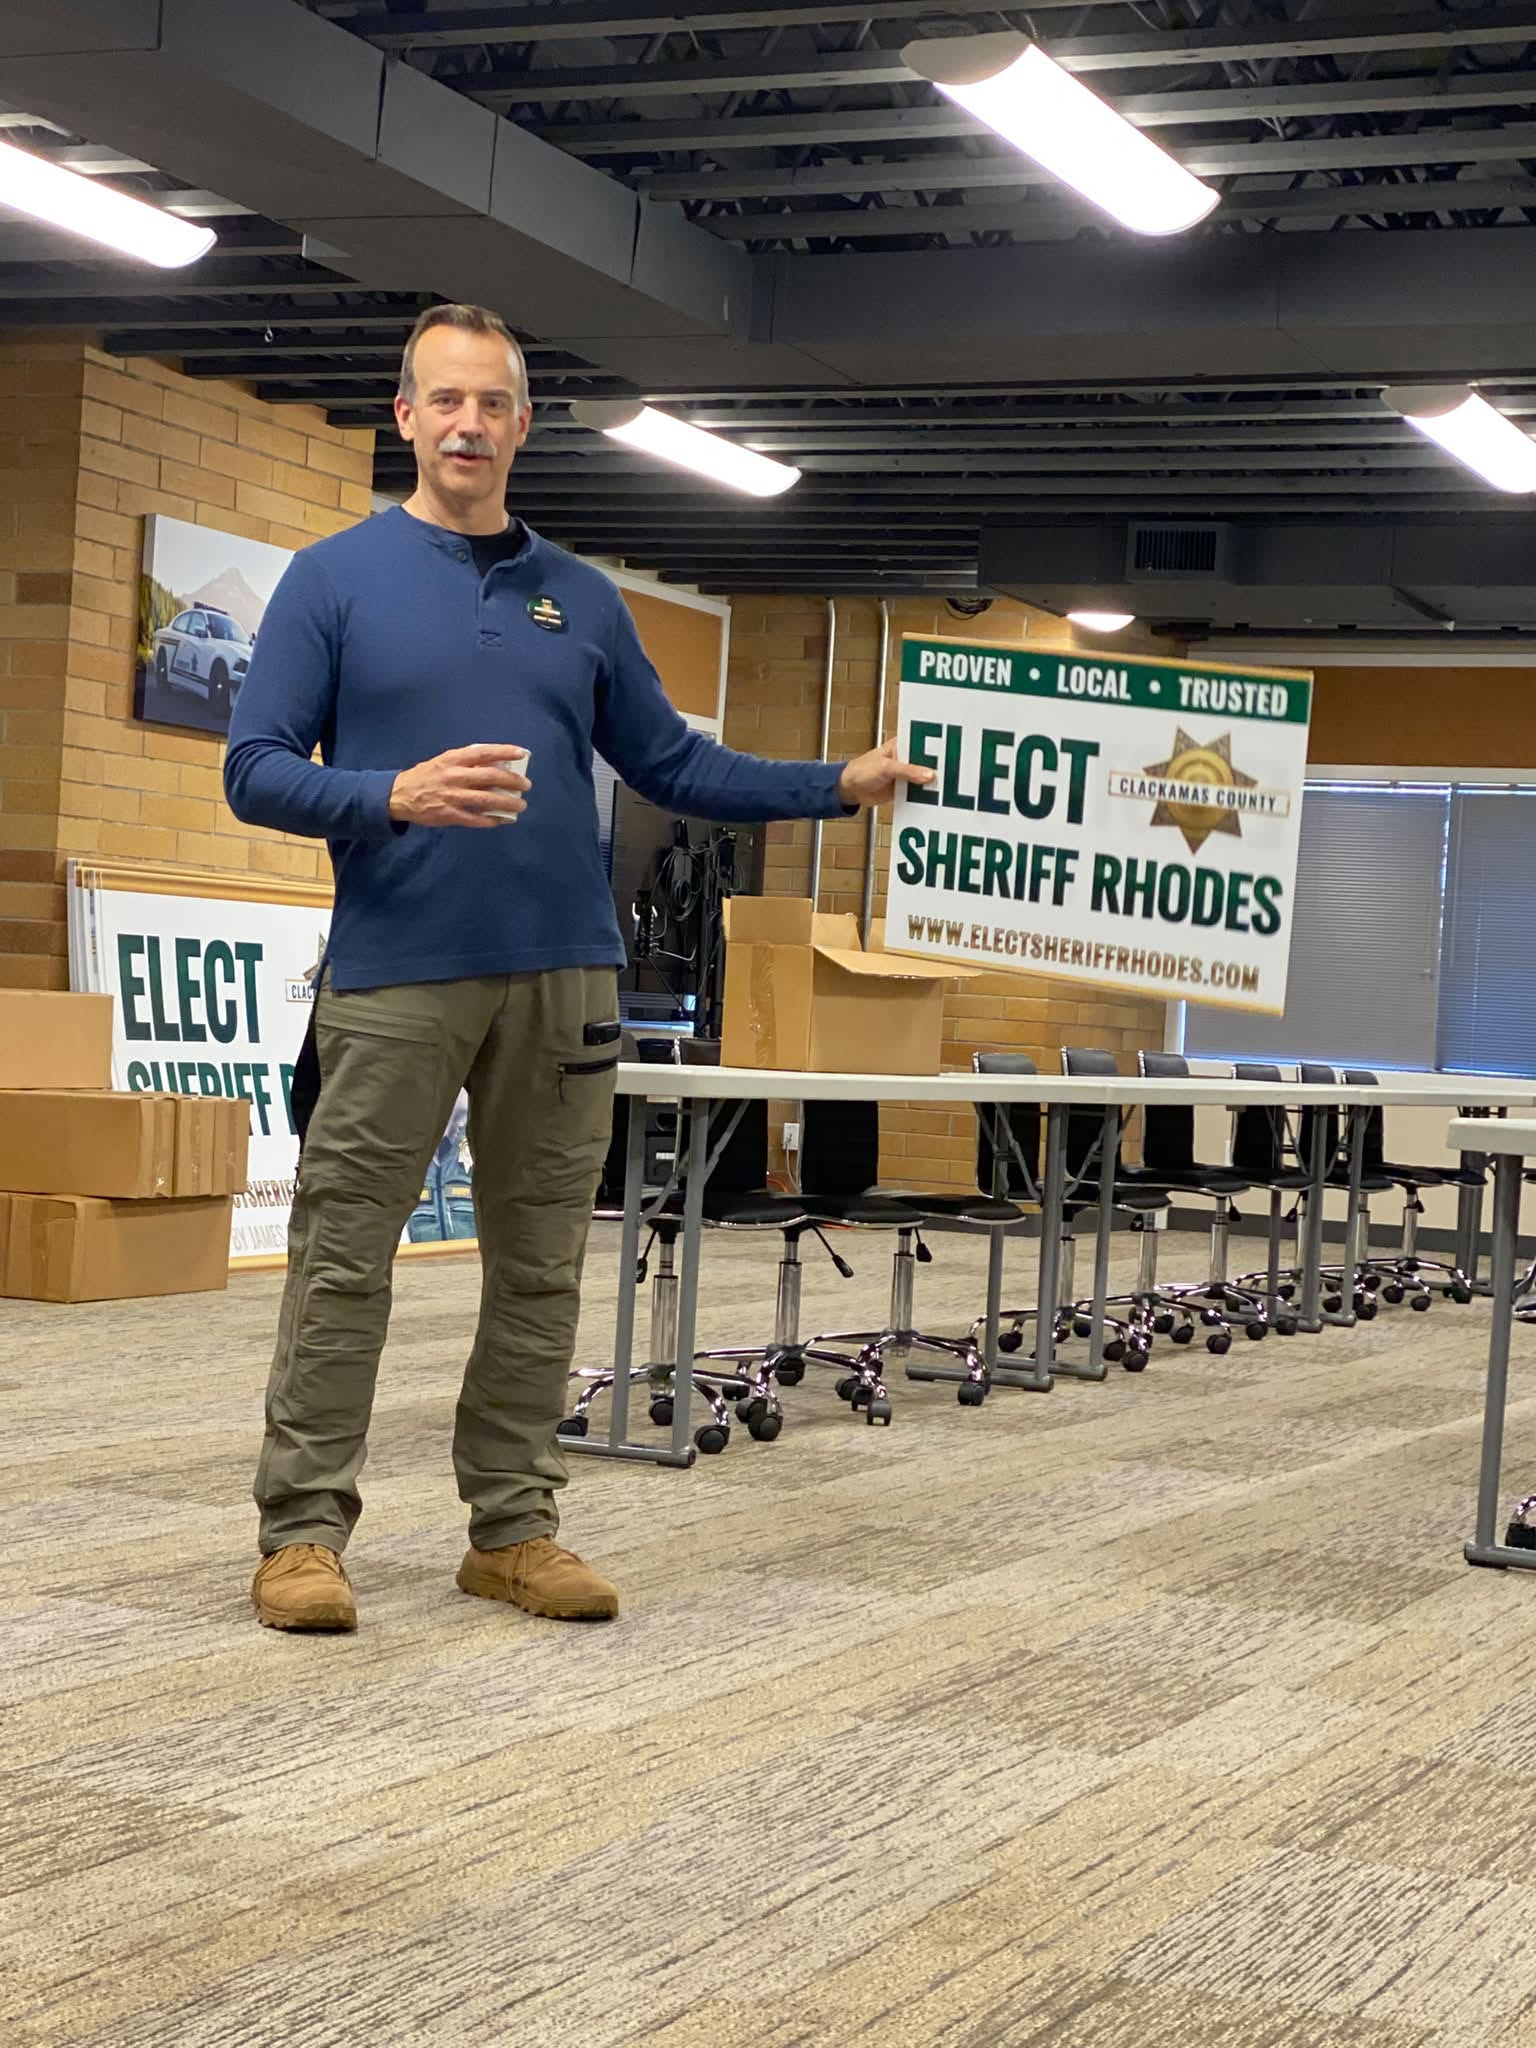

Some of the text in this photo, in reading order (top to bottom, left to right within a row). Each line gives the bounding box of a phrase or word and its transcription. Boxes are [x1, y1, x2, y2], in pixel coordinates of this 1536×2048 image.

[920, 649, 1288, 717] PROVEN LOCAL TRUSTED
[905, 720, 1100, 825] ELECT
[1120, 778, 1277, 811] CLACKAMAS COUNTY
[897, 826, 1283, 936] SHERIFF RHODES
[117, 933, 263, 1043] ELECT
[907, 914, 1260, 993] WWW.ELECTSHERIFFRHODES.COM
